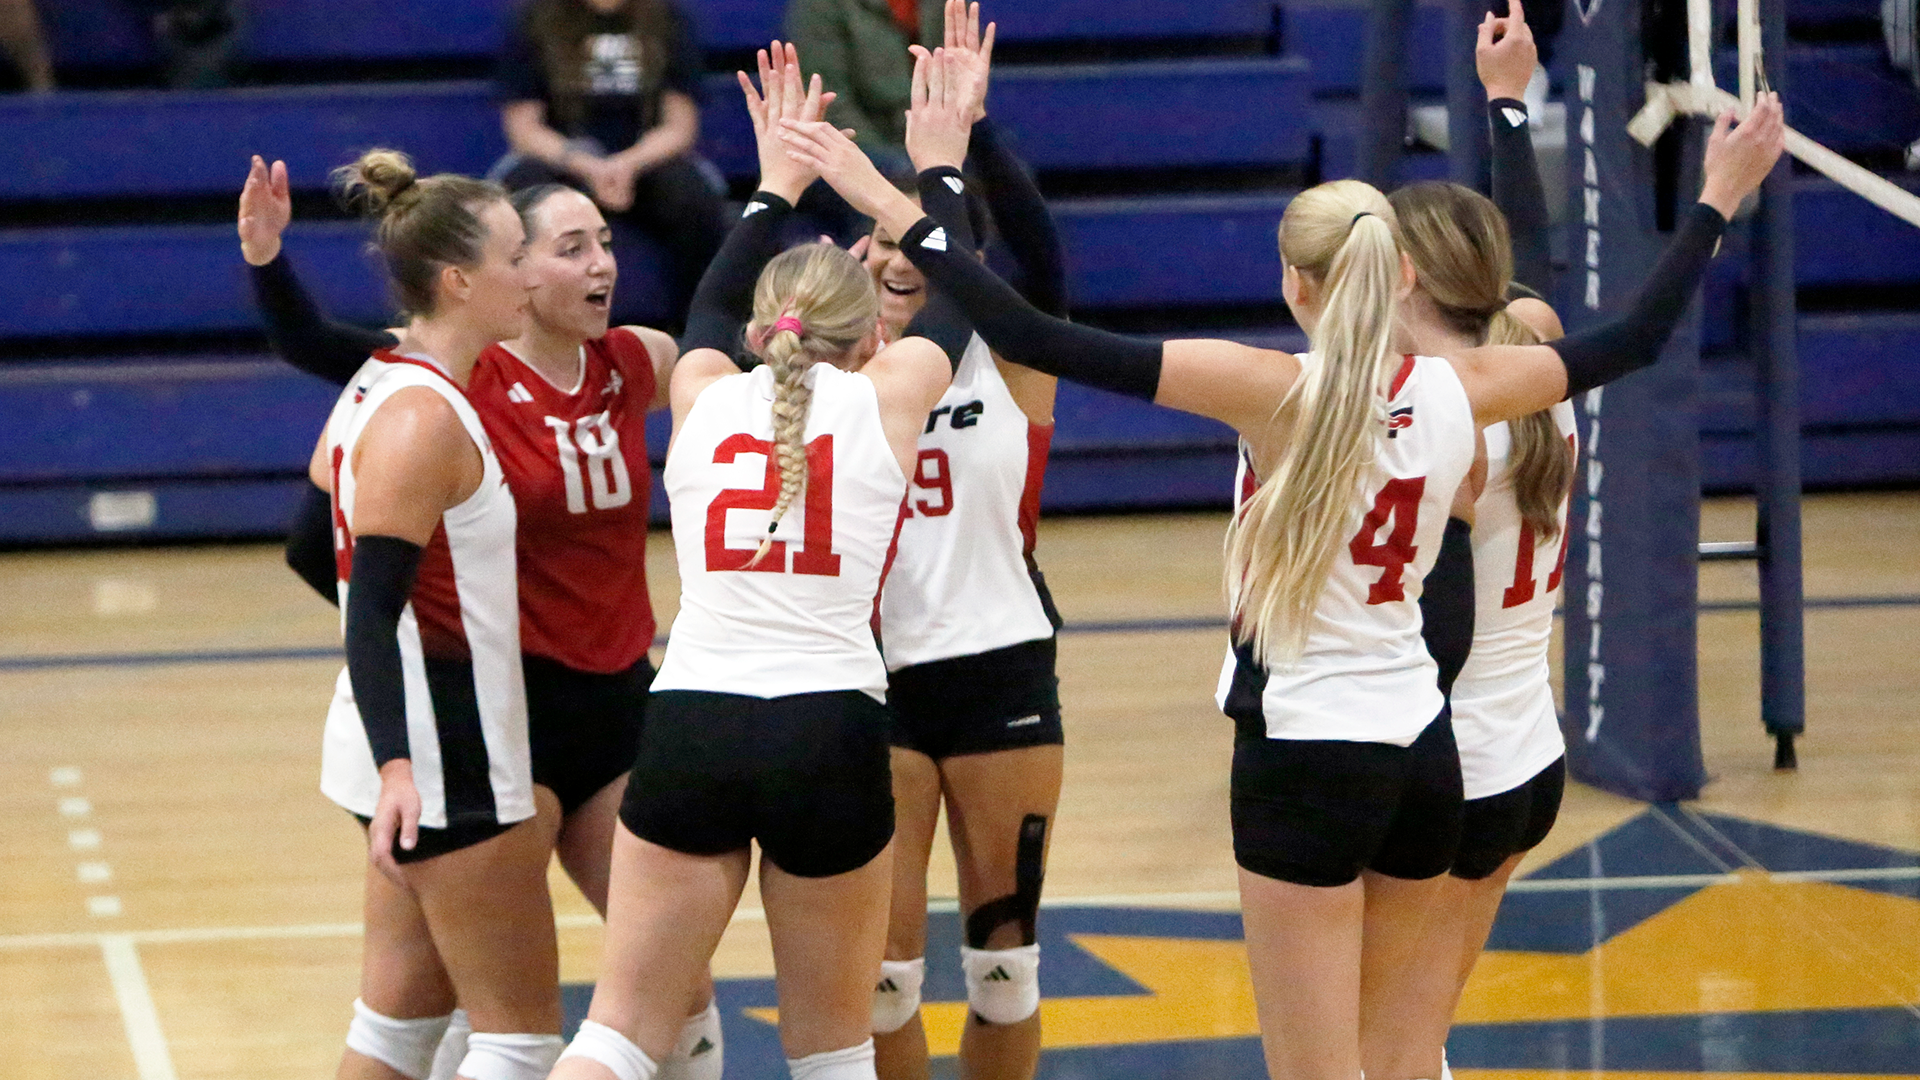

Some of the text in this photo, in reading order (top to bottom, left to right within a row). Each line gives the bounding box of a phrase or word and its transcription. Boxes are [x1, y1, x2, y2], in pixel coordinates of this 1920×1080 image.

[544, 410, 632, 514] 18
[924, 399, 984, 434] re
[704, 432, 841, 577] 21
[900, 447, 954, 519] 9
[1349, 475, 1427, 605] 4
[1584, 385, 1605, 742] NIVERSITY
